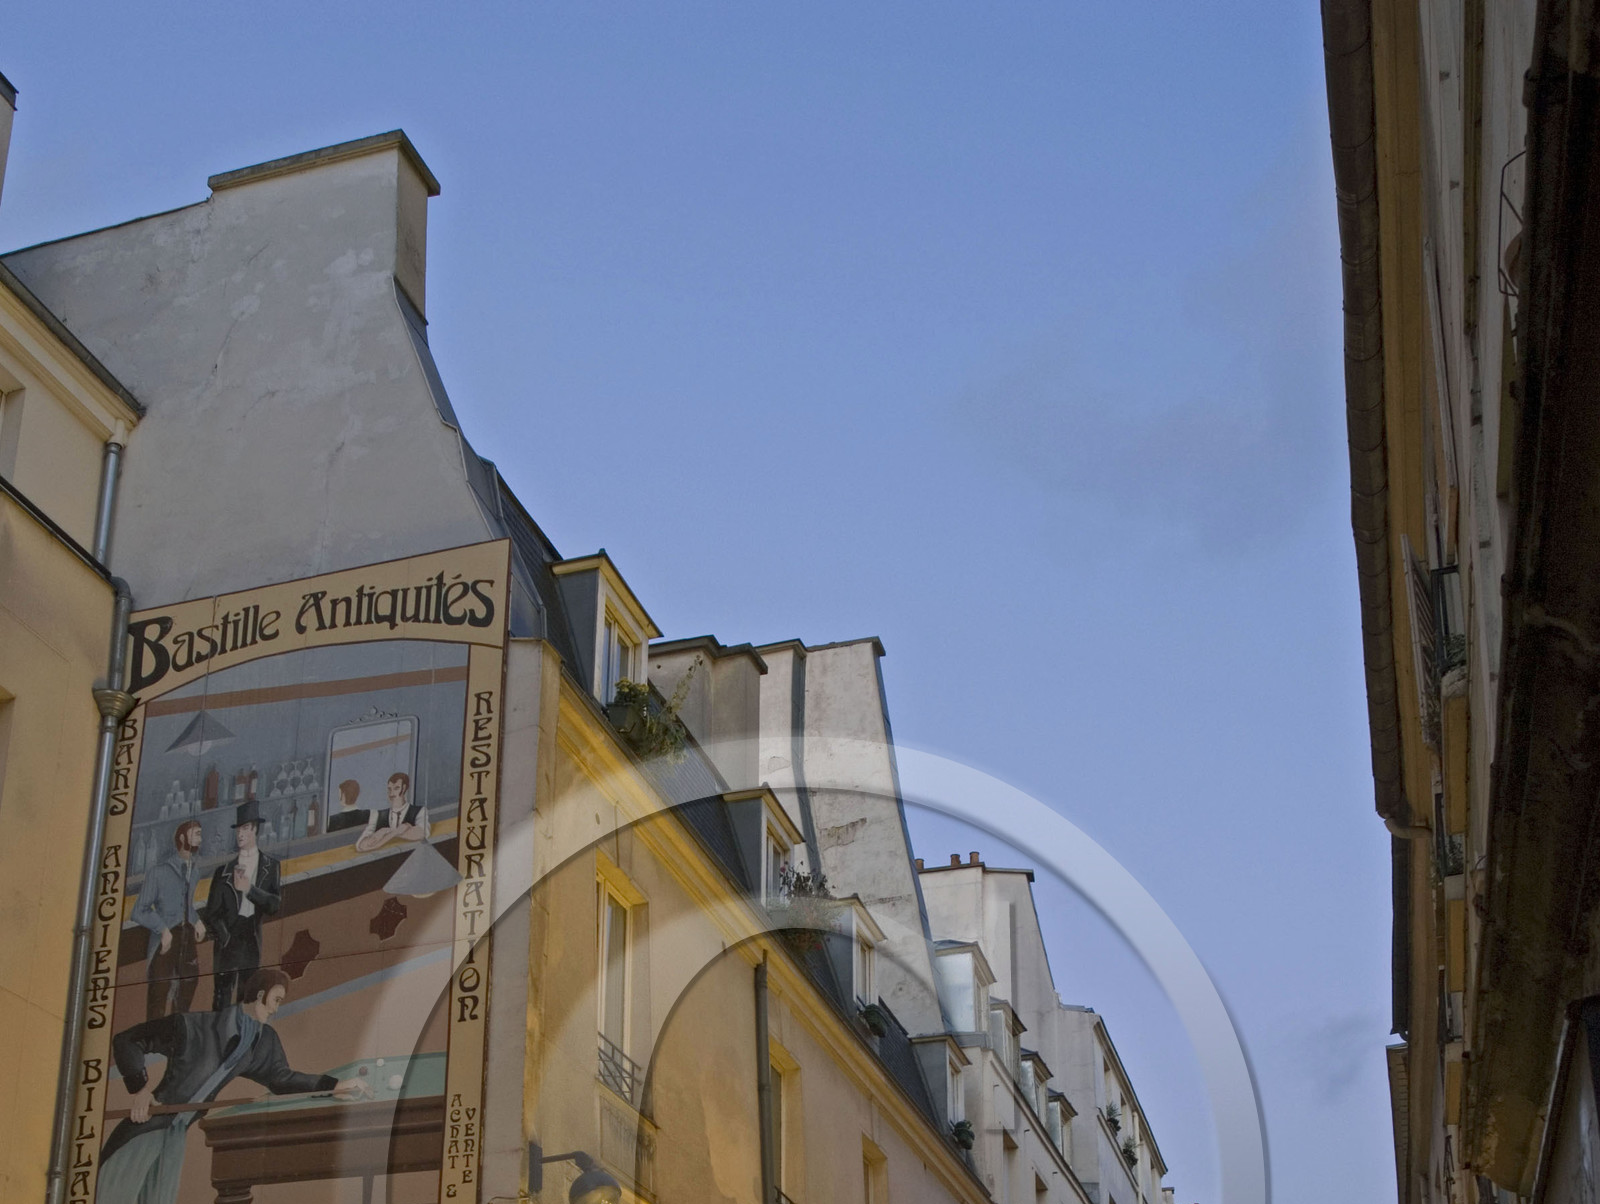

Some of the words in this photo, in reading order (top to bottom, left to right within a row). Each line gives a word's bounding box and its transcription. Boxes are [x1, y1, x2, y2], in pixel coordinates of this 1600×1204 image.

[127, 605, 280, 693] Bastille
[295, 571, 495, 634] Antiquités
[108, 718, 138, 817] BARS
[457, 691, 494, 1022] RESTAURATION
[87, 844, 120, 1030] ANCIENS
[448, 1093, 463, 1170] ACHAT
[462, 1107, 477, 1184] VENTE
